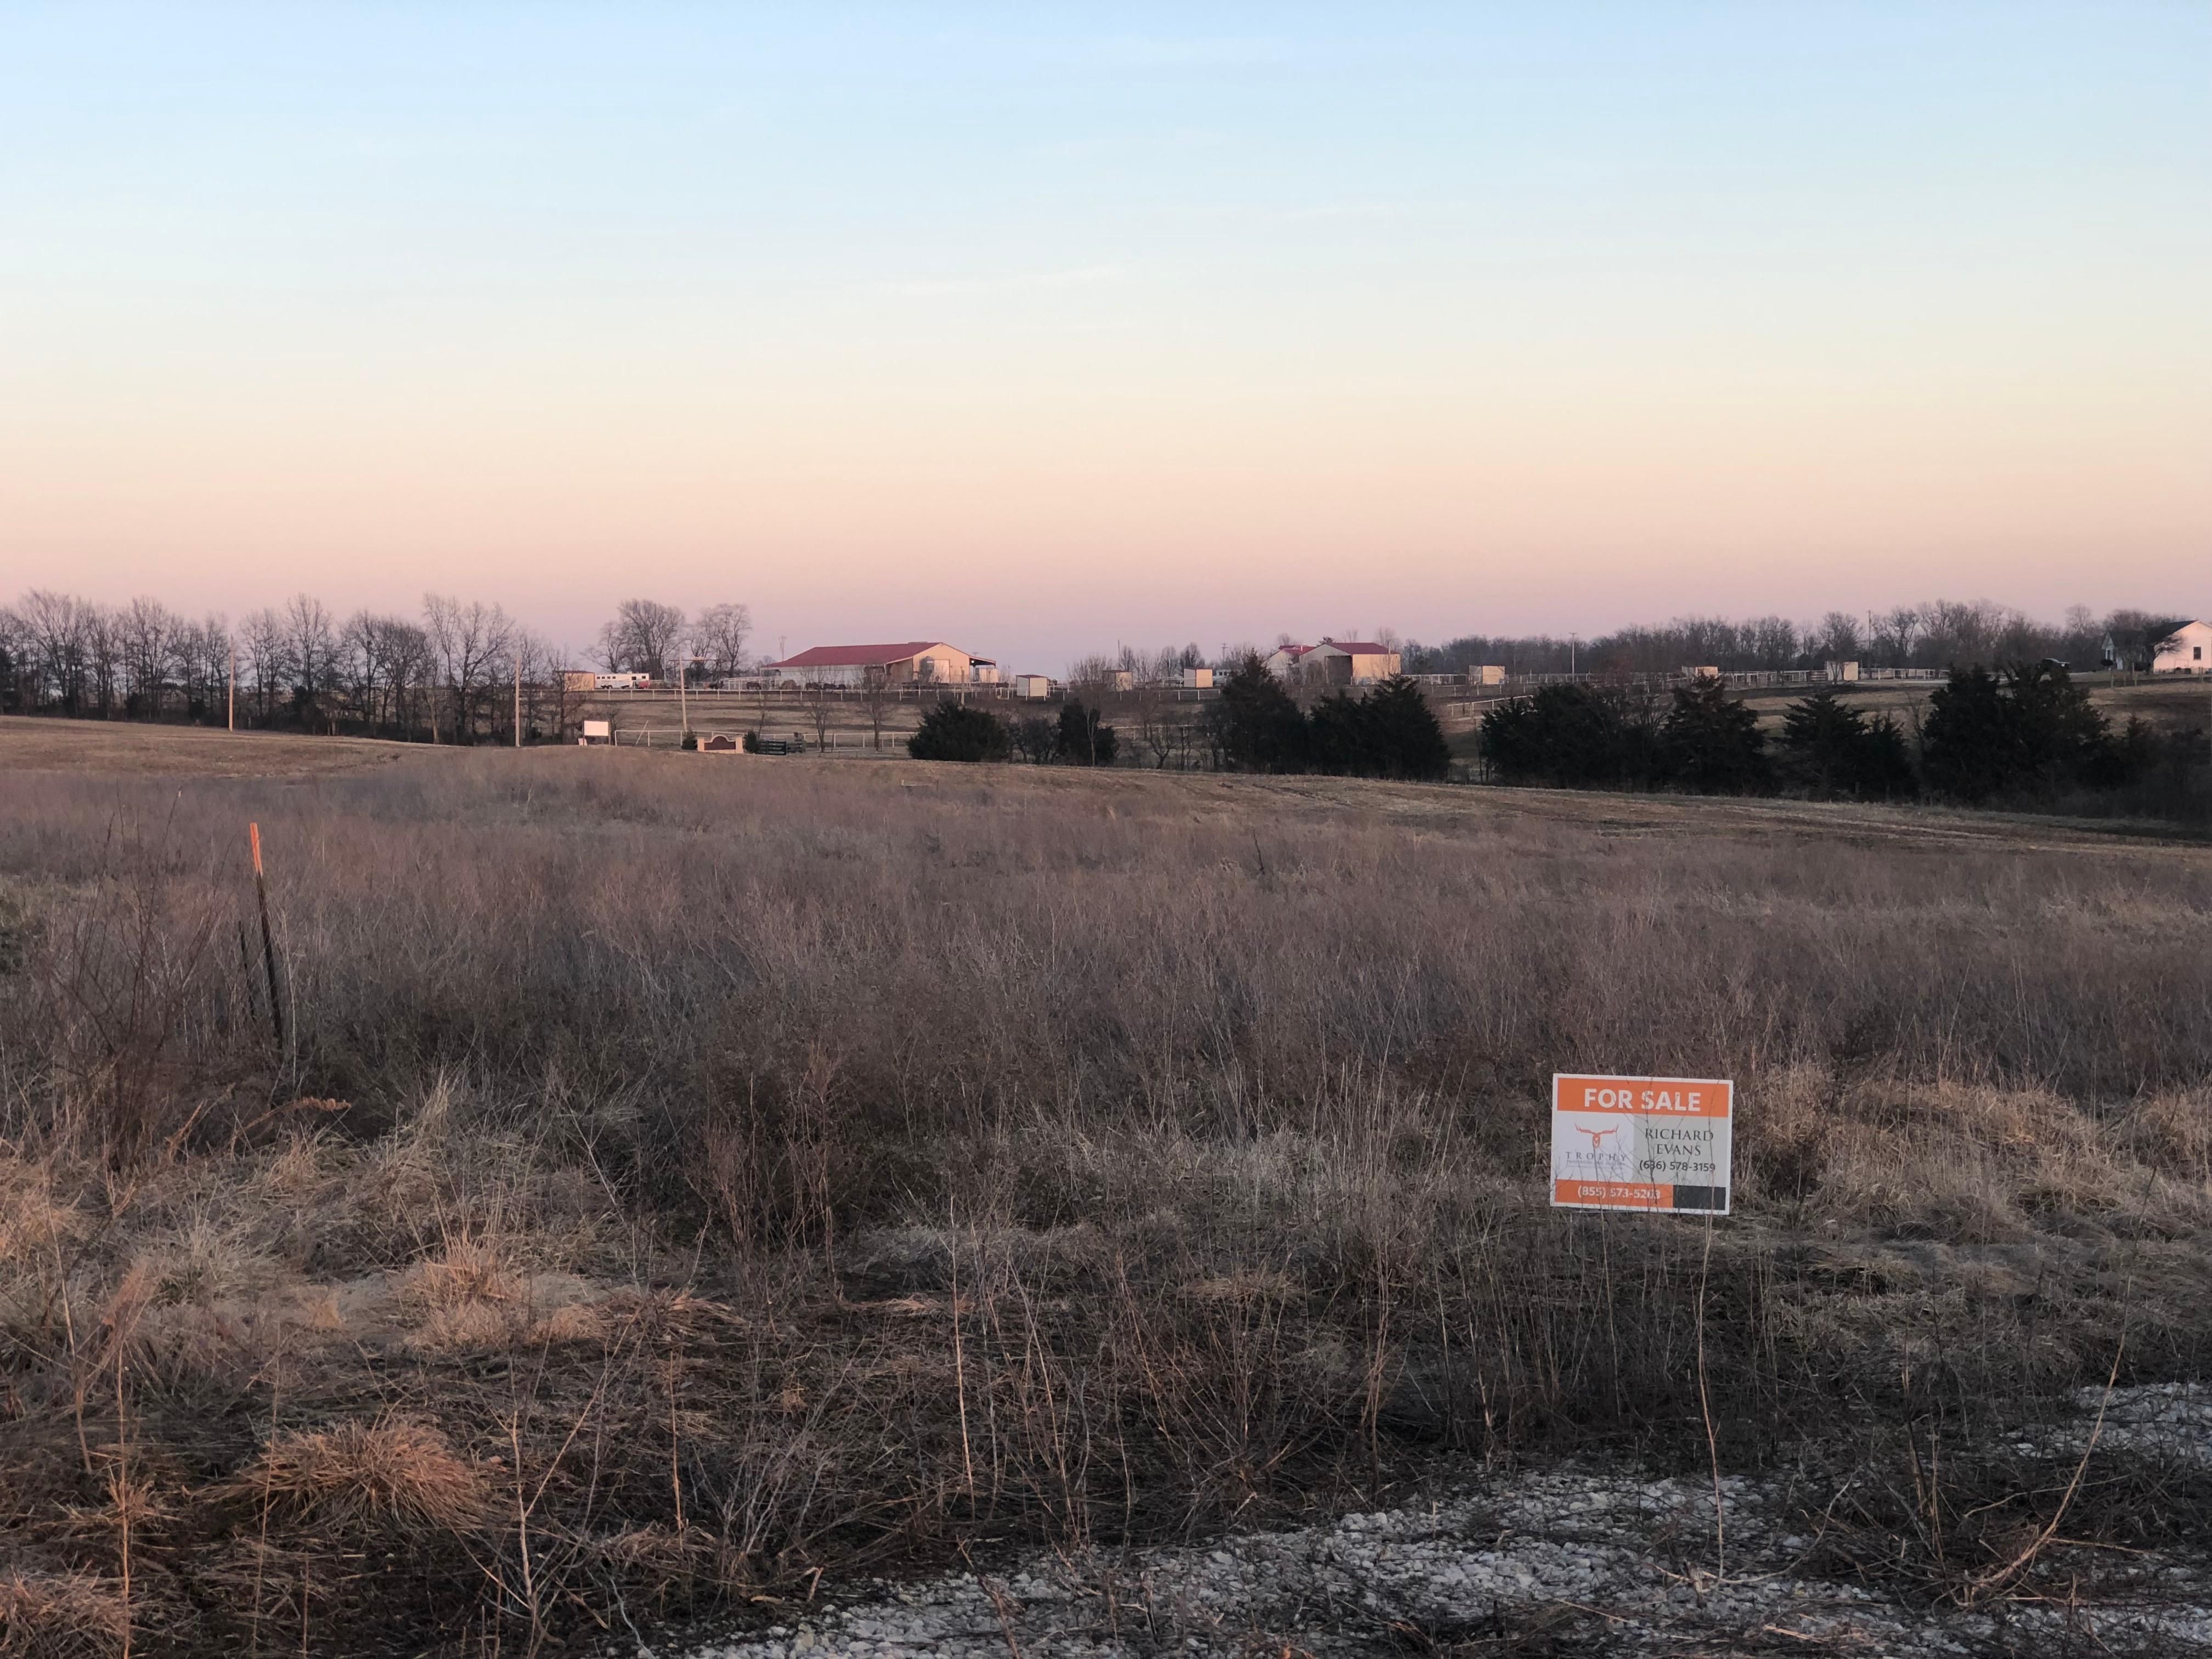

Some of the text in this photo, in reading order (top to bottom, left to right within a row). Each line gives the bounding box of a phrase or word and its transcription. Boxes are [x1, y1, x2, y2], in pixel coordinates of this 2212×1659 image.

[1584, 1088, 1701, 1111] FOR SALE
[1645, 1128, 1714, 1142] RICHARD
[1565, 1152, 1626, 1161] TROPHY
[1657, 1144, 1701, 1156] EVANS
[1639, 1160, 1716, 1172] (636) 578-3159
[1577, 1185, 1606, 1199] (855)
